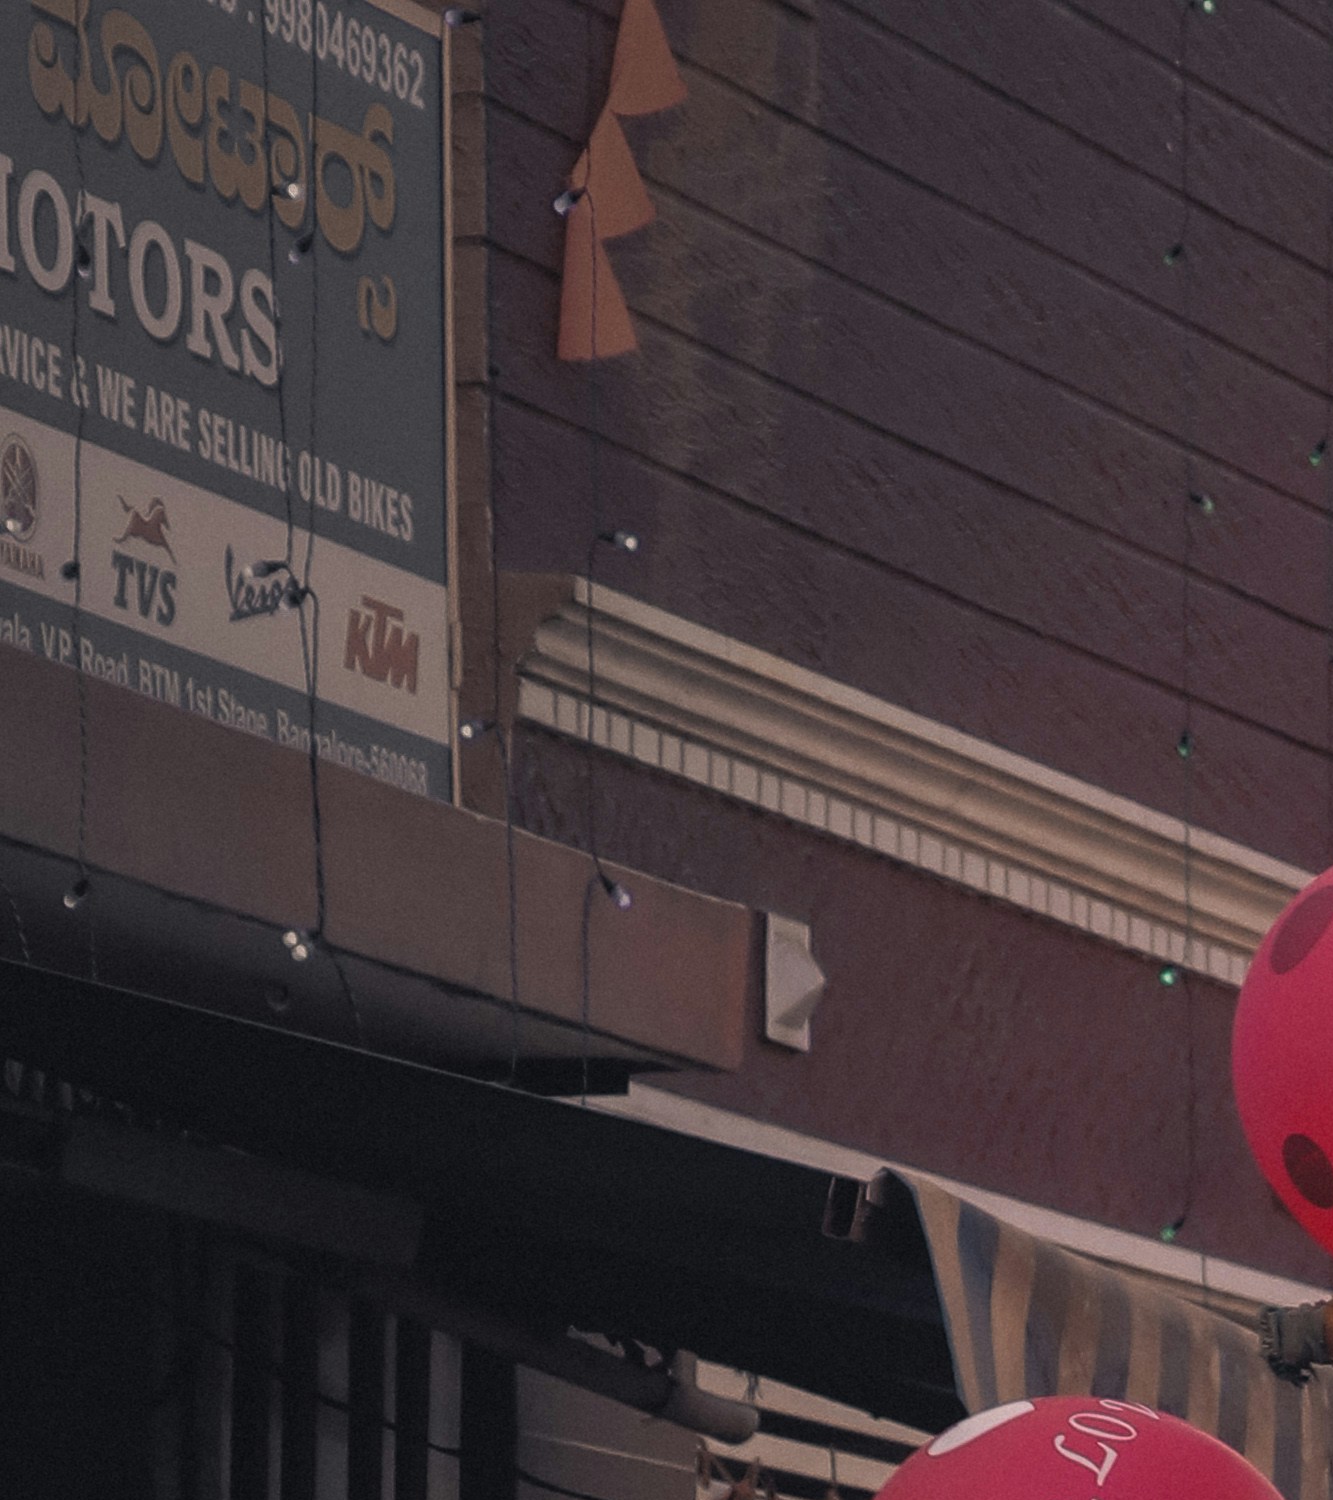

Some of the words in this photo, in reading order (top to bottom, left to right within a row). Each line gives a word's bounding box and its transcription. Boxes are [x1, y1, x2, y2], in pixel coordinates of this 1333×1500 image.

[0, 153, 281, 386] OTORS
[0, 325, 63, 399] VICE
[70, 355, 90, 408] &
[97, 364, 137, 429] WE
[144, 385, 192, 452] ARE
[198, 408, 294, 493] SELLING
[299, 450, 342, 513] OLD
[348, 471, 414, 543] BIKES
[112, 549, 177, 628] TVS
[343, 594, 420, 695] KTM
